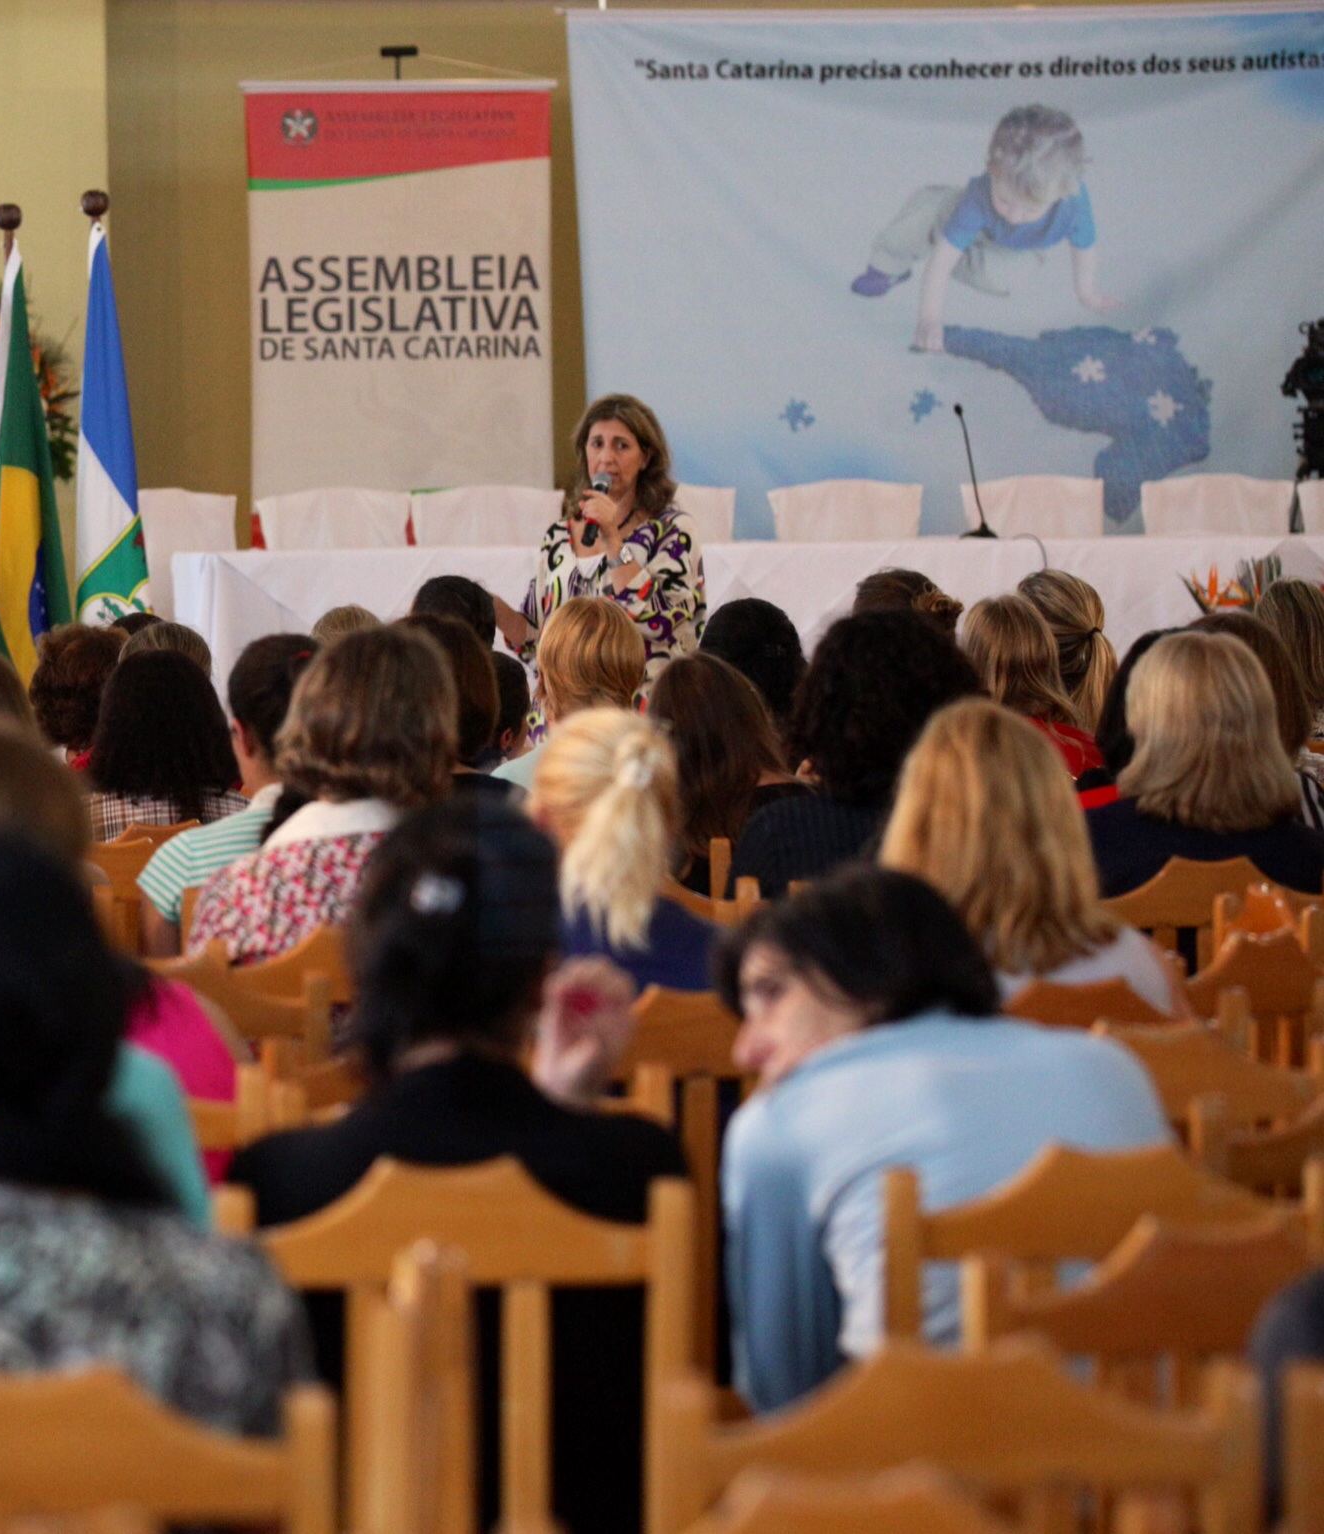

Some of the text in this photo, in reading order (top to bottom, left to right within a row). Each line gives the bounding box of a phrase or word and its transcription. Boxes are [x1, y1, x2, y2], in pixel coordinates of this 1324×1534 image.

[715, 58, 813, 80] Catarina
[820, 59, 903, 84] precisa
[908, 56, 1013, 79] conhecer
[1018, 61, 1045, 78] os
[1049, 55, 1137, 76] direitos
[1142, 52, 1182, 75] dos
[1186, 55, 1236, 74] seus
[1241, 48, 1324, 72] autista
[259, 254, 541, 292] ASSEMBLEIA
[260, 295, 540, 333] LEGISLATIVA
[260, 335, 542, 361] DE SANTA CATARINA
